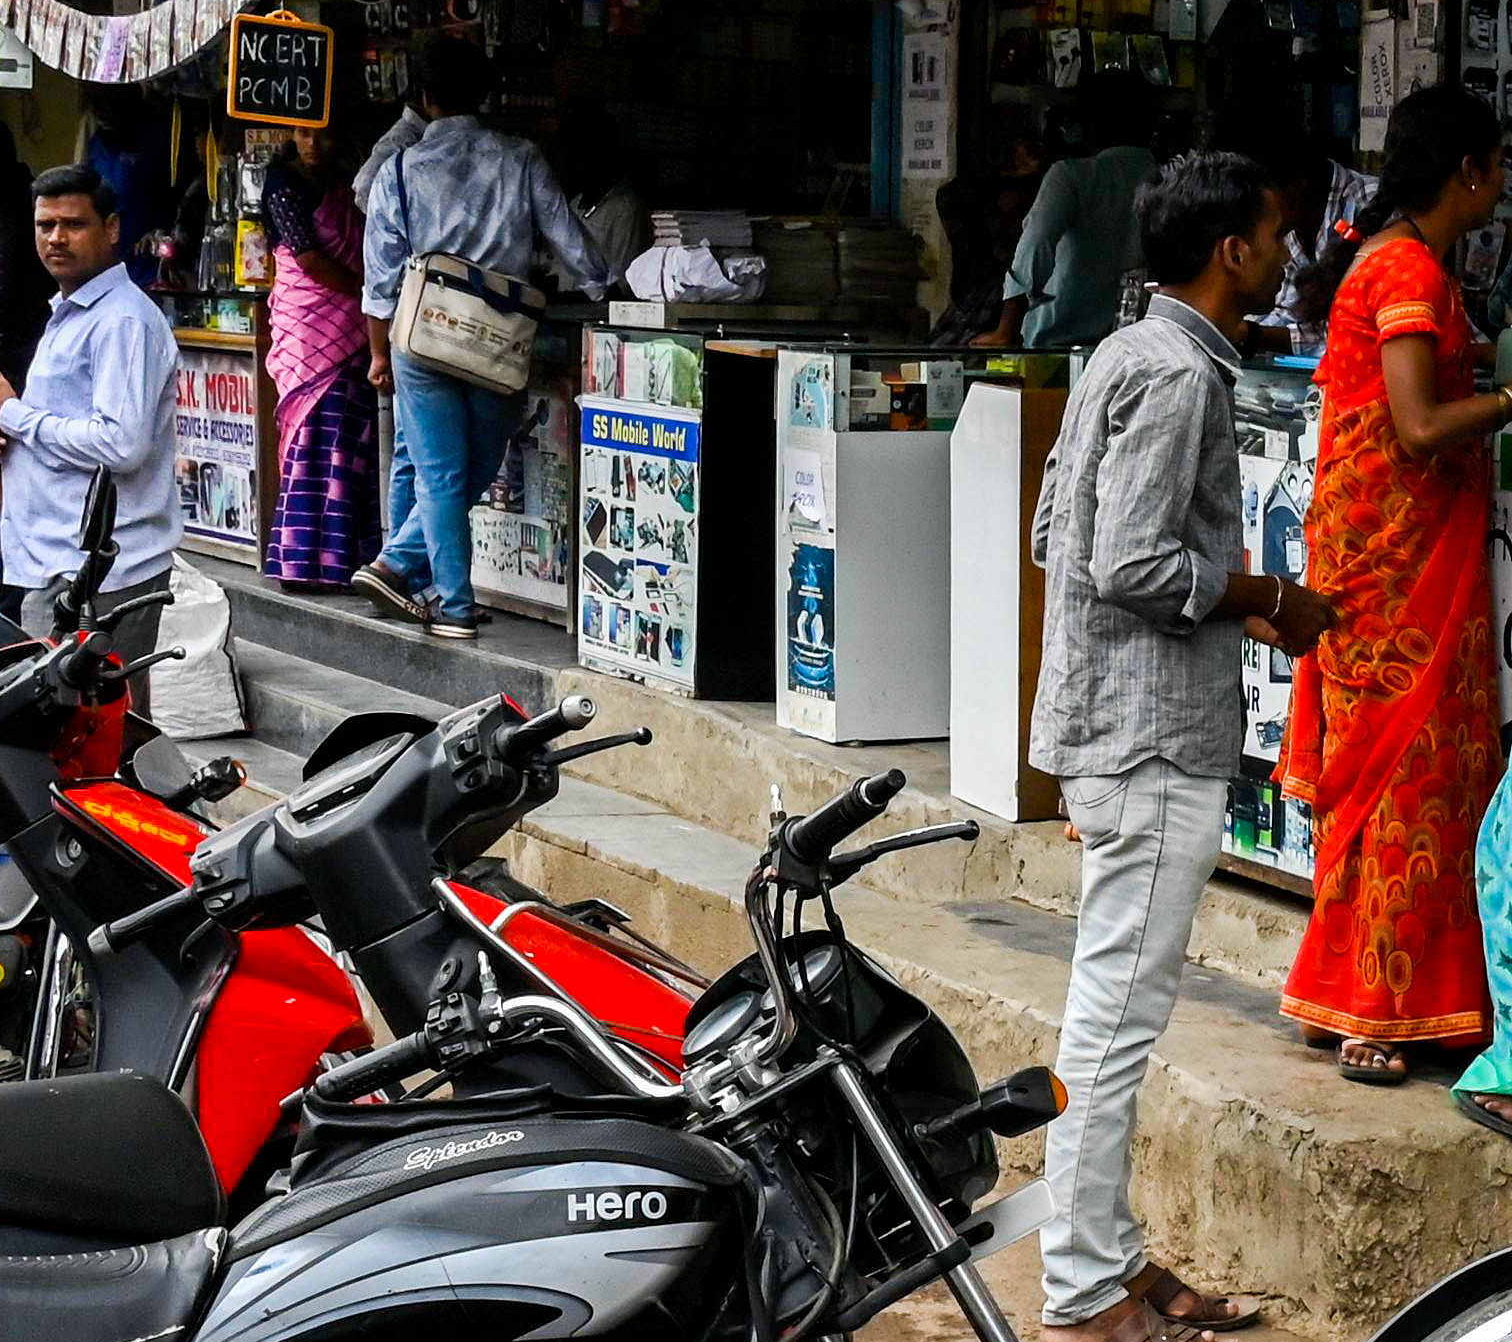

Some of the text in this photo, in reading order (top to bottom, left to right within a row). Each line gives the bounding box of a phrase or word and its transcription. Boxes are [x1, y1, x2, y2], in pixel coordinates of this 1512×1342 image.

[240, 32, 326, 67] NCERT
[592, 414, 686, 451] SS Mobile World
[402, 1128, 525, 1172] Splendor
